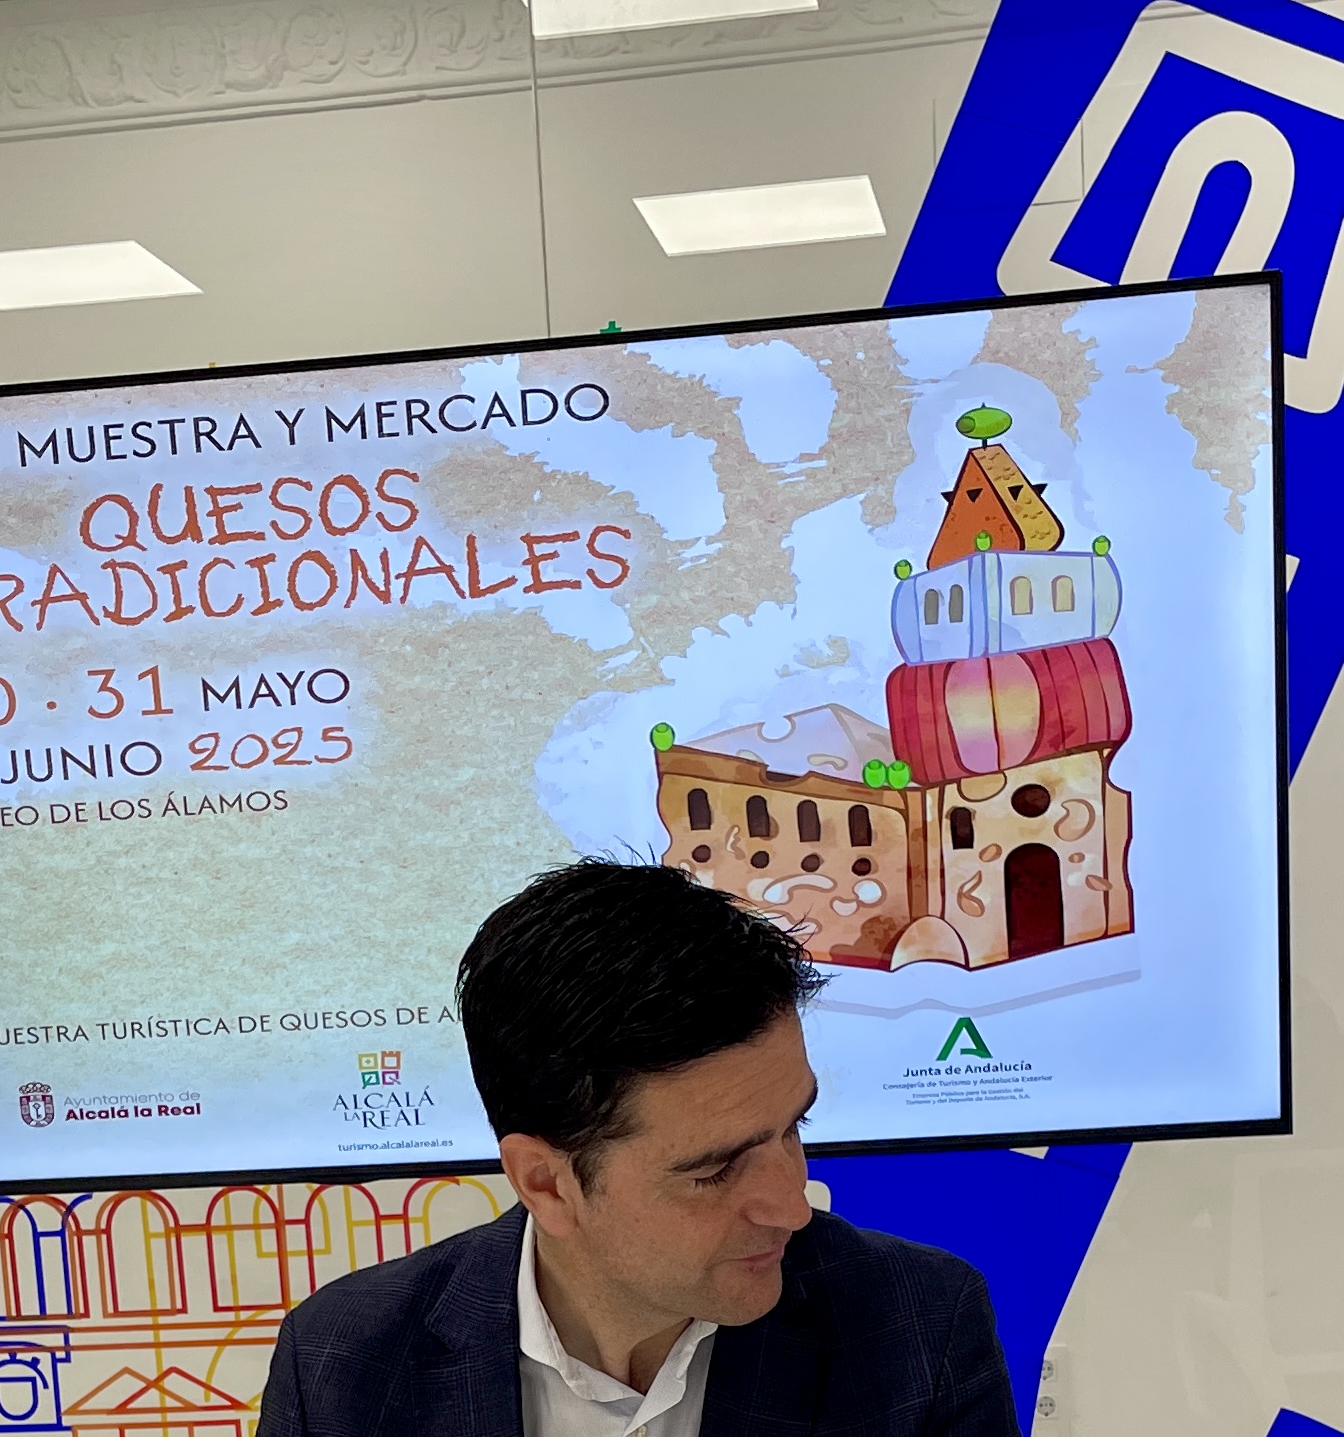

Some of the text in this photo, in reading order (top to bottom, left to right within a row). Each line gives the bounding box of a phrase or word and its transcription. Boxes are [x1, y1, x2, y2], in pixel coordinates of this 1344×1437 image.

[18, 415, 263, 469] MUESTRA
[276, 408, 304, 447] Y
[325, 382, 610, 443] MERCADO
[79, 468, 421, 554] QUESOS
[87, 664, 175, 719] 31
[202, 668, 351, 714] MAYO
[0, 740, 161, 786] JUNIO
[189, 726, 353, 773] 2025
[50, 802, 90, 825] DE
[99, 798, 152, 822] LOS
[161, 789, 289, 819] ÁLAMOS
[96, 1016, 230, 1041] TURÍSTICA
[238, 1014, 272, 1033] DE
[279, 1008, 387, 1032] QUESOS
[396, 1006, 430, 1025] DE
[903, 1060, 1032, 1078] Junta de Andalucía
[926, 1079, 937, 1088] de
[939, 1078, 971, 1087] Turismo
[63, 1090, 201, 1107] Ayuntamiento de
[332, 1085, 434, 1111] ALCALÁ
[65, 1102, 201, 1121] Alcalá la Real
[343, 1108, 427, 1130] LA REAL
[338, 1138, 454, 1152] turismo.alcalalareal.es
